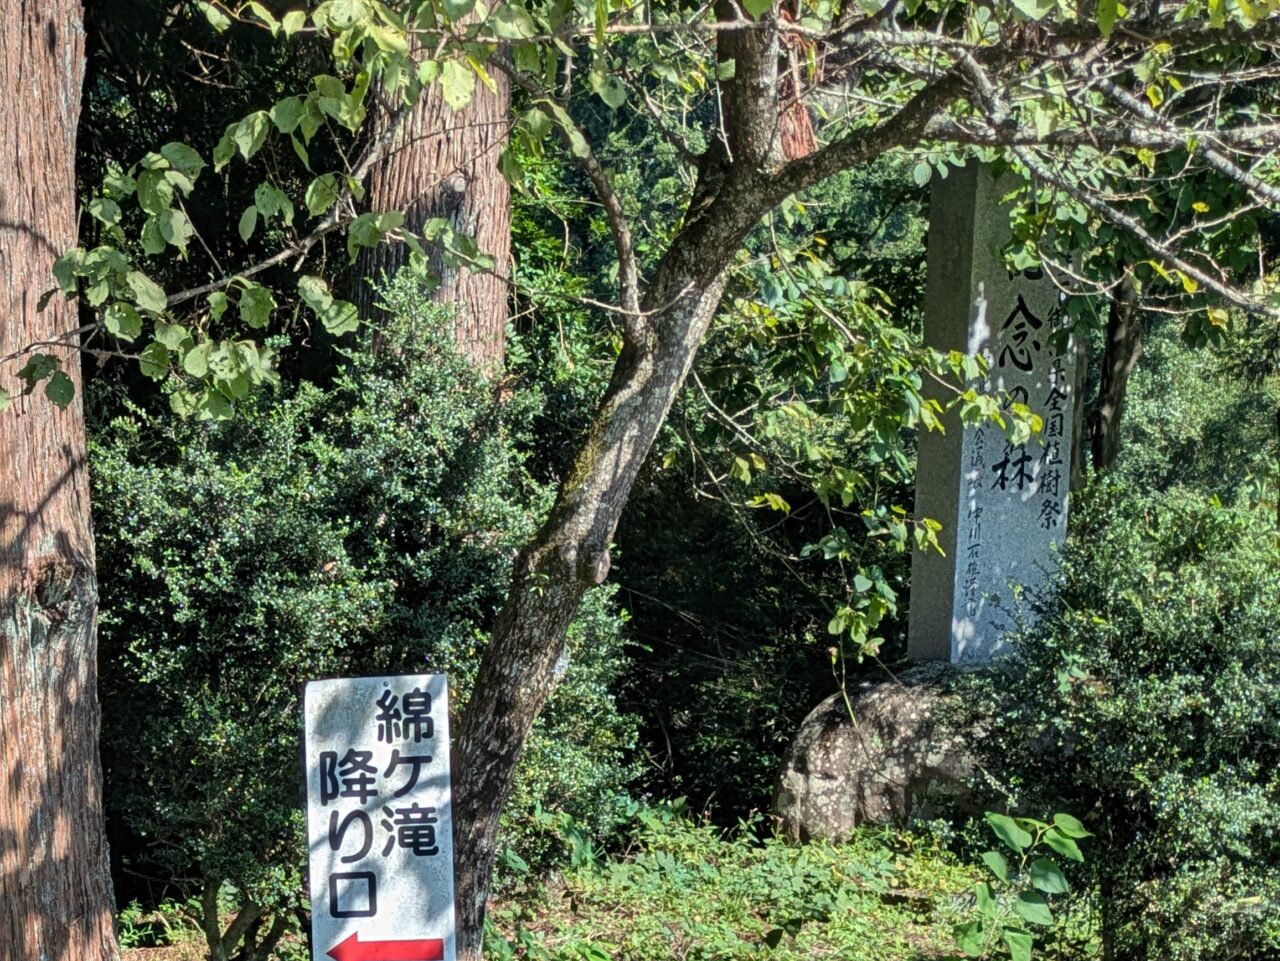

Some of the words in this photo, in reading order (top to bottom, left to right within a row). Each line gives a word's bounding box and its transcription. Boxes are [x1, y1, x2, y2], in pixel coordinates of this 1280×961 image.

[991, 264, 1043, 491] 念の森
[319, 748, 379, 919] 降り口
